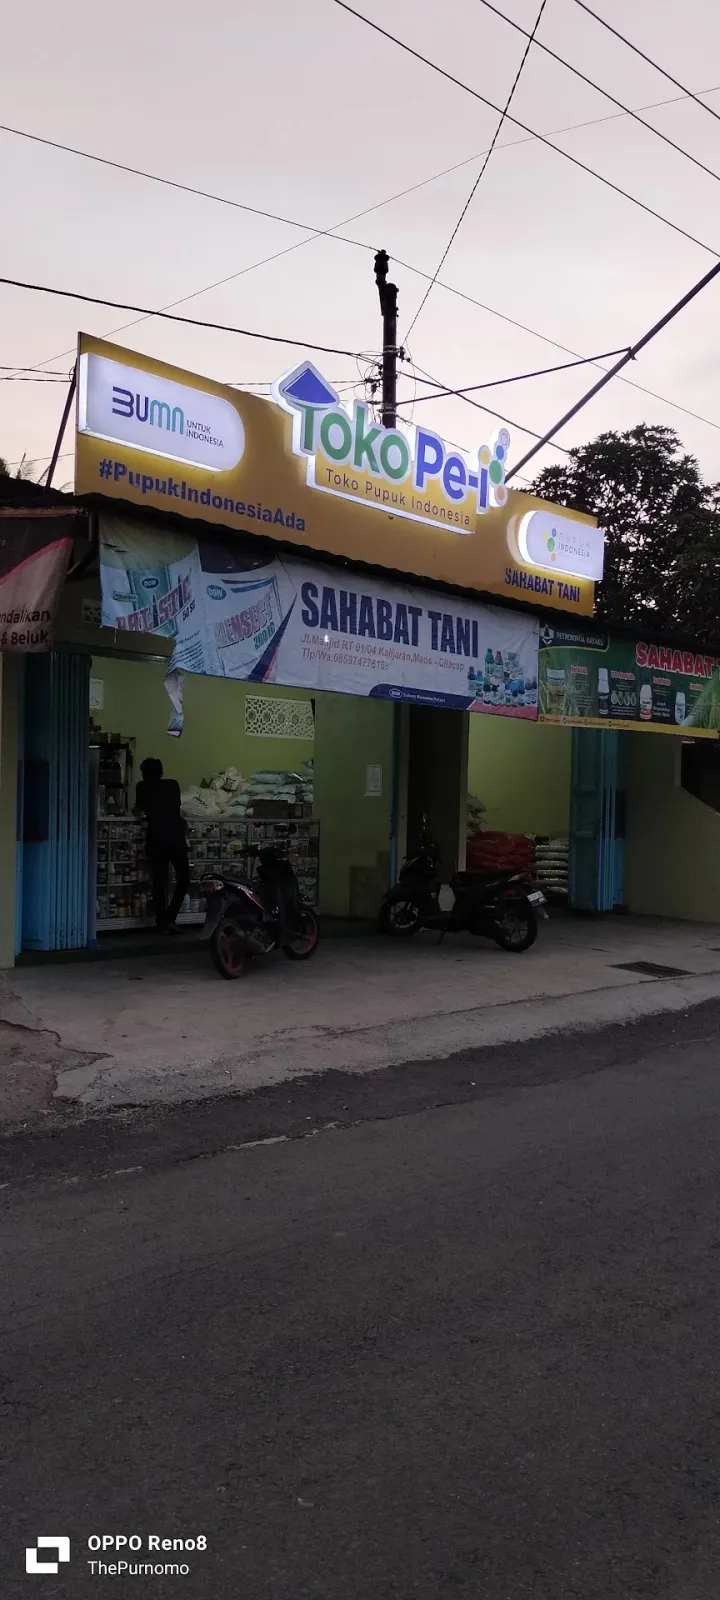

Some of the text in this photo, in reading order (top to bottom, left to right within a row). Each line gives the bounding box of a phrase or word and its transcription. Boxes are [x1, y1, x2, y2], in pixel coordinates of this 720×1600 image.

[186, 420, 211, 435] UNTUK
[186, 429, 224, 448] INDONESIA
[99, 458, 306, 532] #PupukIndonesiaAda
[326, 468, 471, 526] Toko Pupuk Indonesia
[558, 542, 590, 558] INDONESIA
[559, 532, 591, 550] PUPUK
[504, 569, 580, 603] SAHABAT TANI
[0, 608, 50, 624] ndalikan
[301, 581, 478, 658] SAHABAT TANI
[1, 629, 48, 645] & Beluk
[341, 640, 354, 651] RT
[635, 641, 714, 679] SAHABAT
